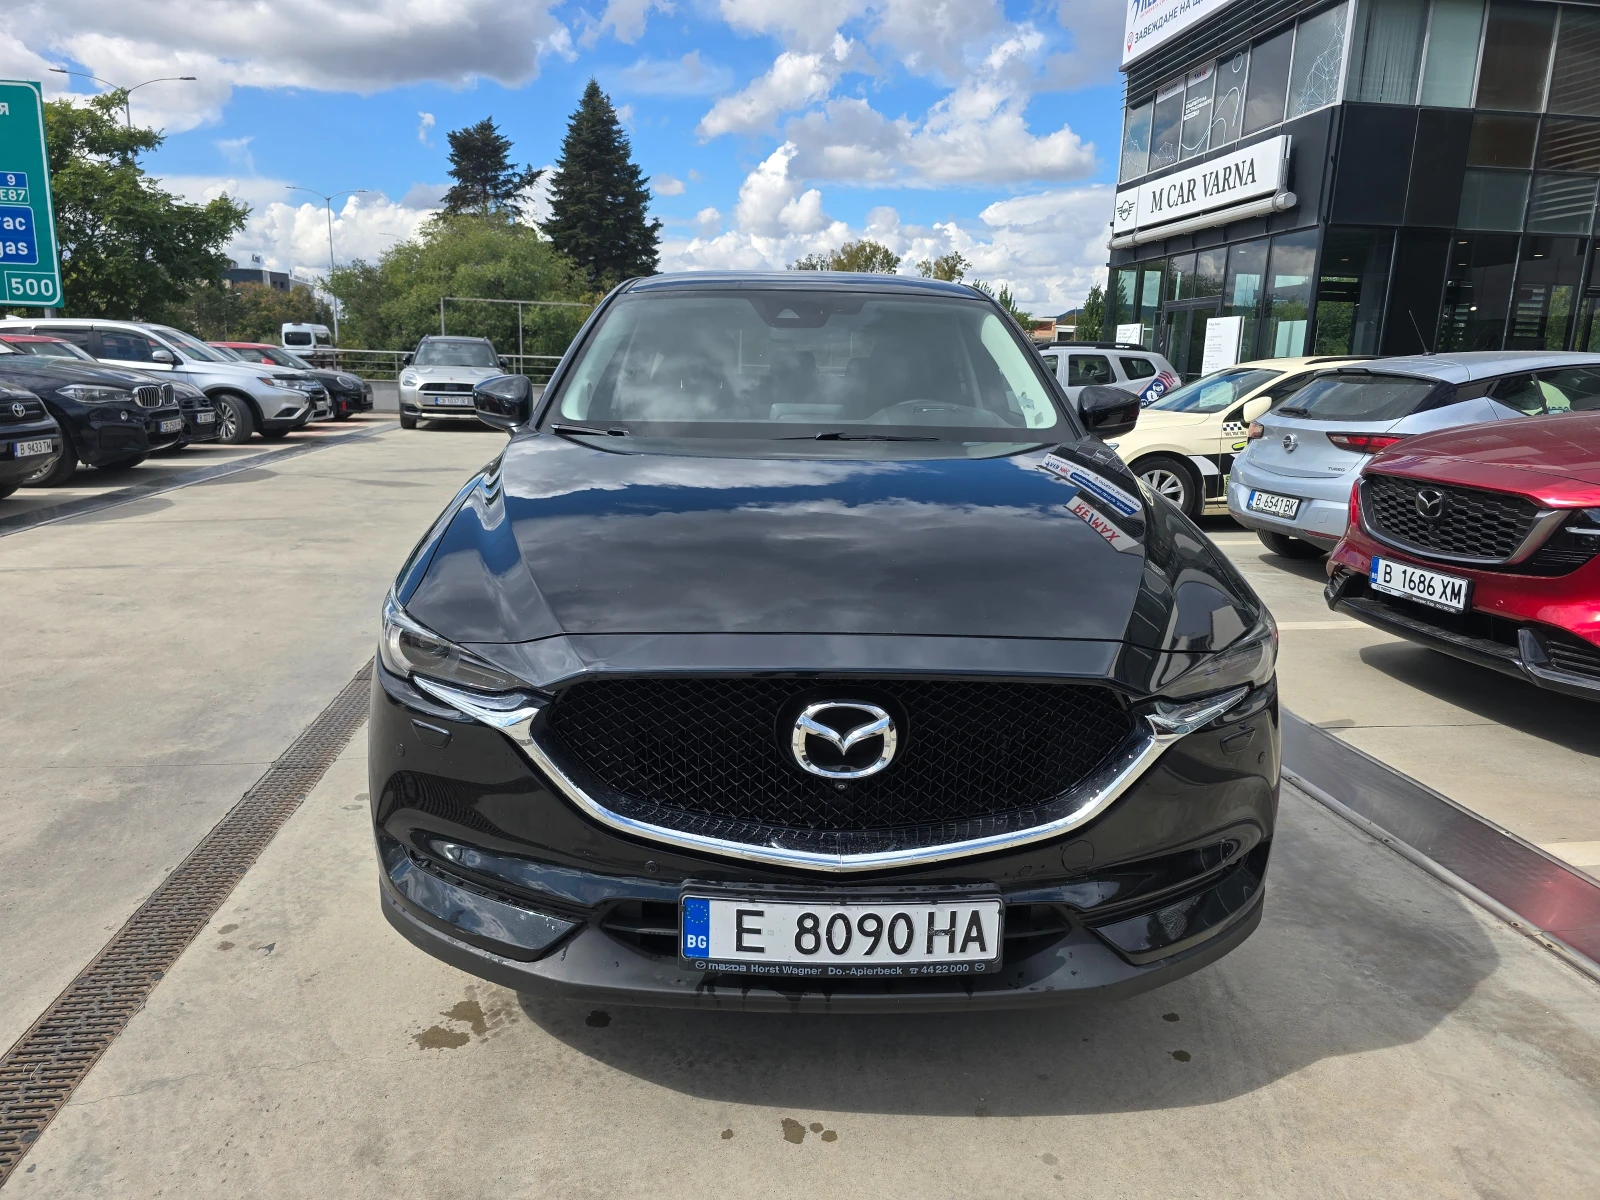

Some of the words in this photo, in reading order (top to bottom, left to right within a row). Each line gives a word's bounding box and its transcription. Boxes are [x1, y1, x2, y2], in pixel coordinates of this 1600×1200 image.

[1134, 6, 1178, 44] ЗАВЕЖДАНЕ
[1180, 0, 1190, 15] НА
[7, 174, 16, 186] 9
[1150, 187, 1165, 214] M
[1167, 178, 1197, 209] CAR
[1201, 157, 1257, 199] VARNA
[0, 189, 26, 202] E87
[11, 277, 54, 297] 500
[20, 444, 25, 455] B
[28, 442, 42, 454] 9433
[44, 440, 52, 451] TM
[1255, 494, 1263, 506] B
[1263, 496, 1284, 513] 6541
[1284, 499, 1297, 515] BK
[1383, 563, 1393, 584] B
[1402, 569, 1436, 597] 1686
[1439, 578, 1463, 605] XM
[687, 935, 707, 949] BG
[735, 908, 765, 953] E
[794, 911, 914, 955] 8090
[925, 909, 988, 955] HA
[708, 962, 747, 973] mazda
[750, 964, 780, 974] Horst
[782, 965, 822, 976] Wagner
